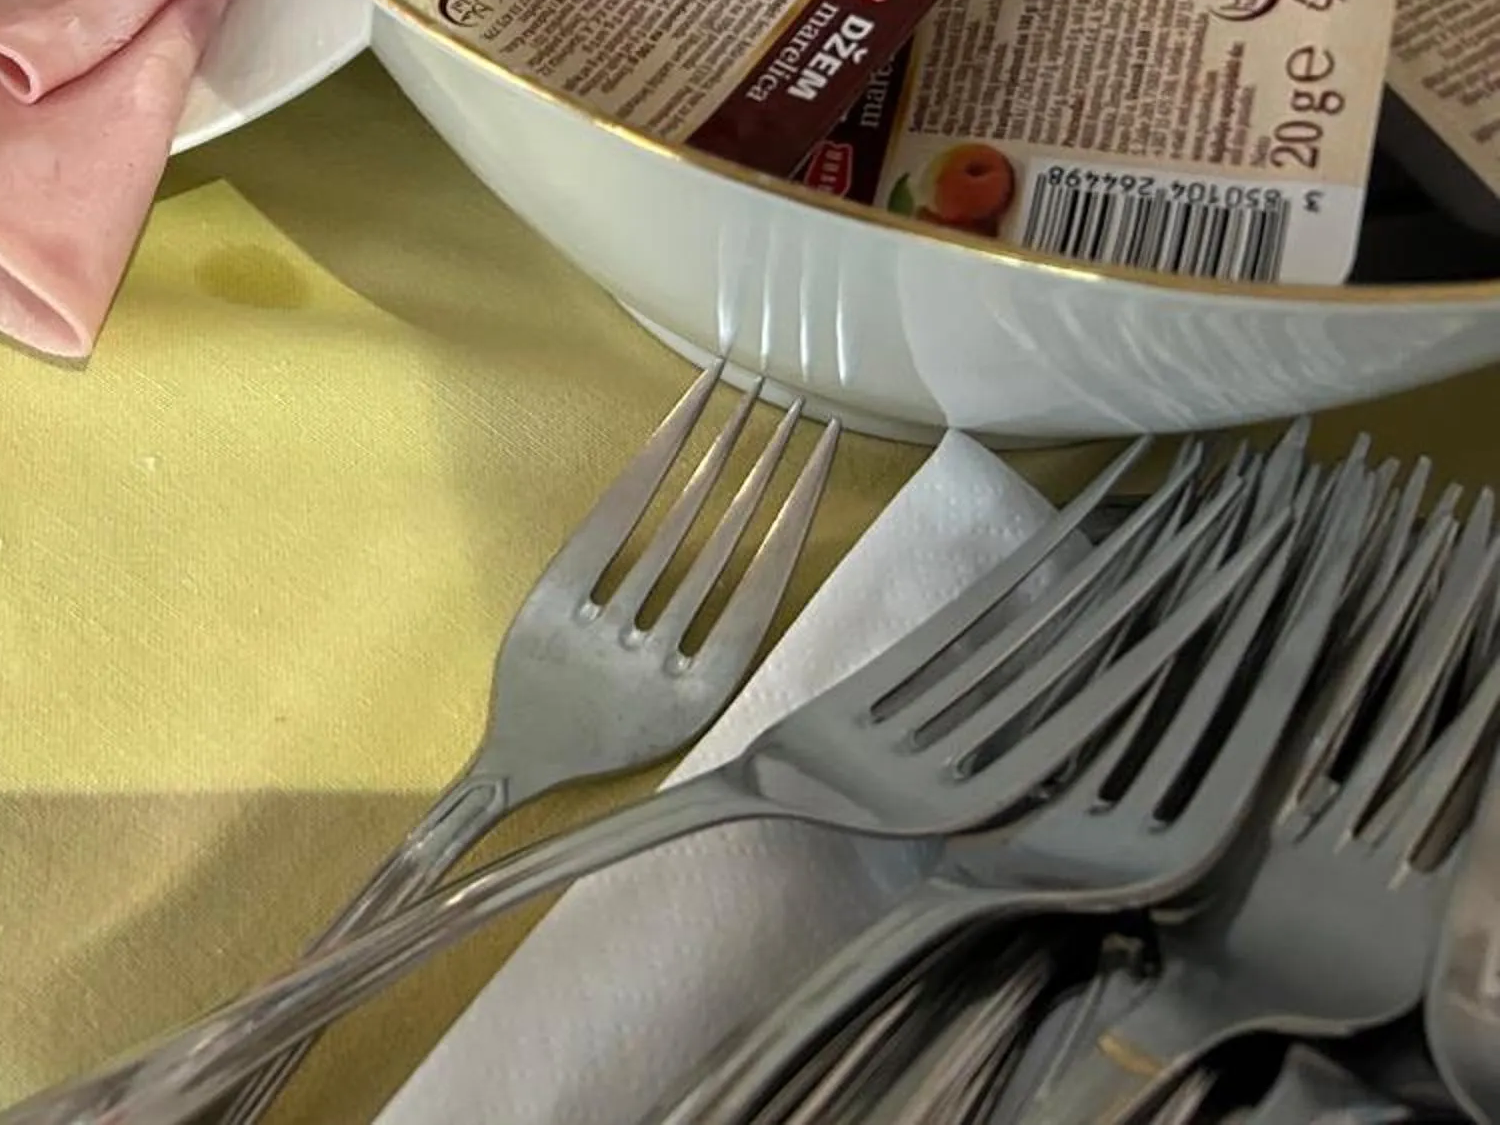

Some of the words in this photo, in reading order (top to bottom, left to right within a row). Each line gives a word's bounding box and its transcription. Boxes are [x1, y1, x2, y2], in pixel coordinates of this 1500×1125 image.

[745, 1, 840, 102] marelica
[787, 14, 875, 102] DŽEM
[1269, 120, 1323, 169] 20
[1048, 165, 1154, 196] 264498
[1171, 180, 1282, 210] 850104
[1304, 189, 1324, 213] 3
